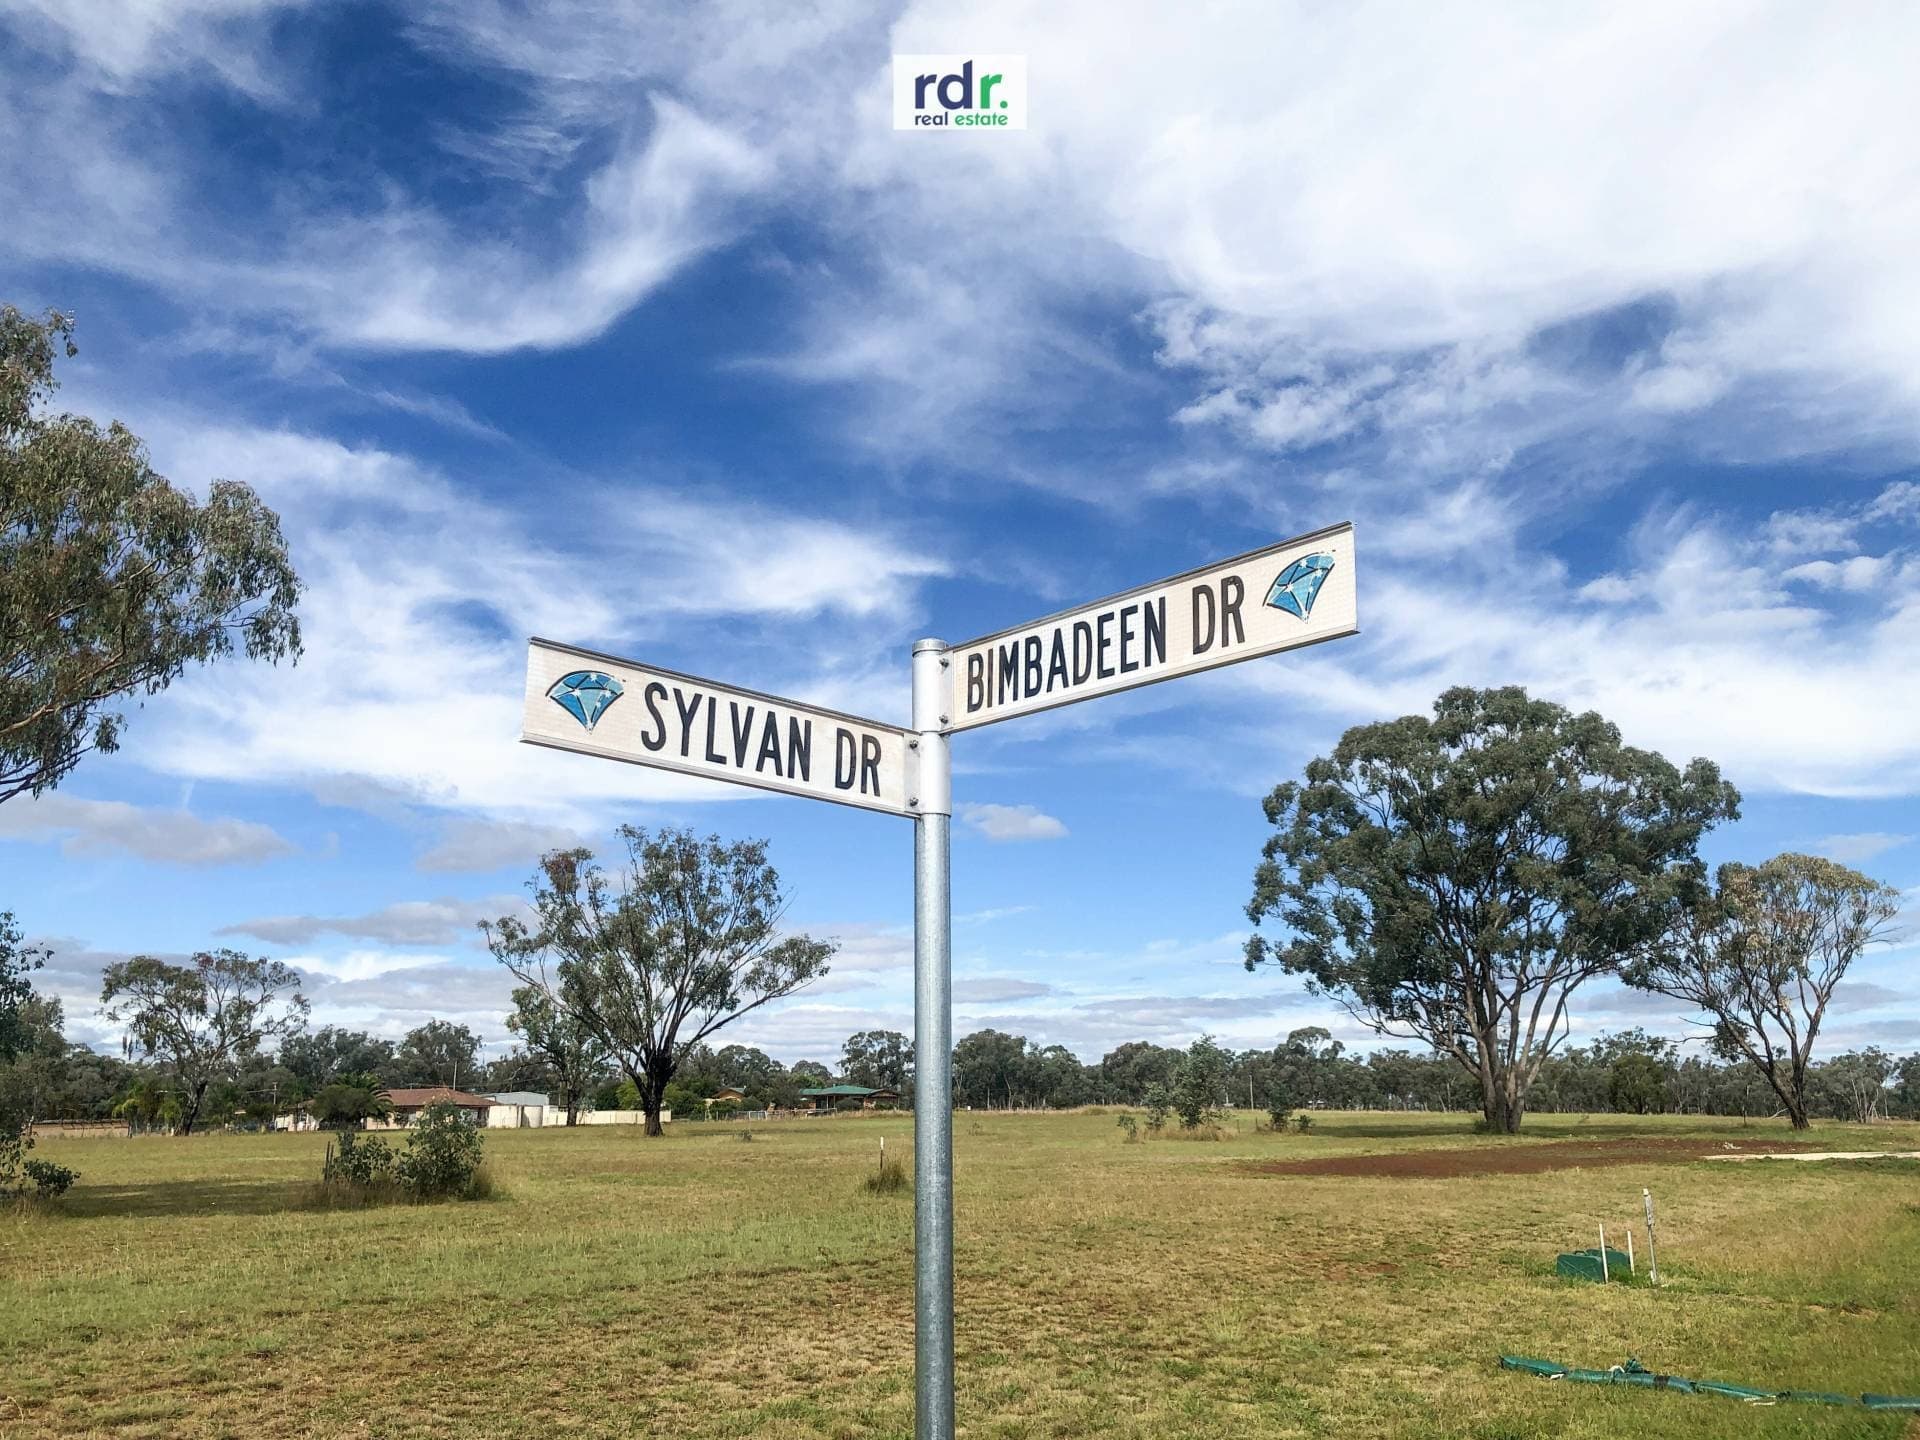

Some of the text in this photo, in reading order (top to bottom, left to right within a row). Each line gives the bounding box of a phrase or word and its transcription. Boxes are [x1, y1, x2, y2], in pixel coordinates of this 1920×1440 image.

[967, 575, 1245, 713] BIMBADEEN DR
[641, 682, 882, 797] SYLVAN DR
